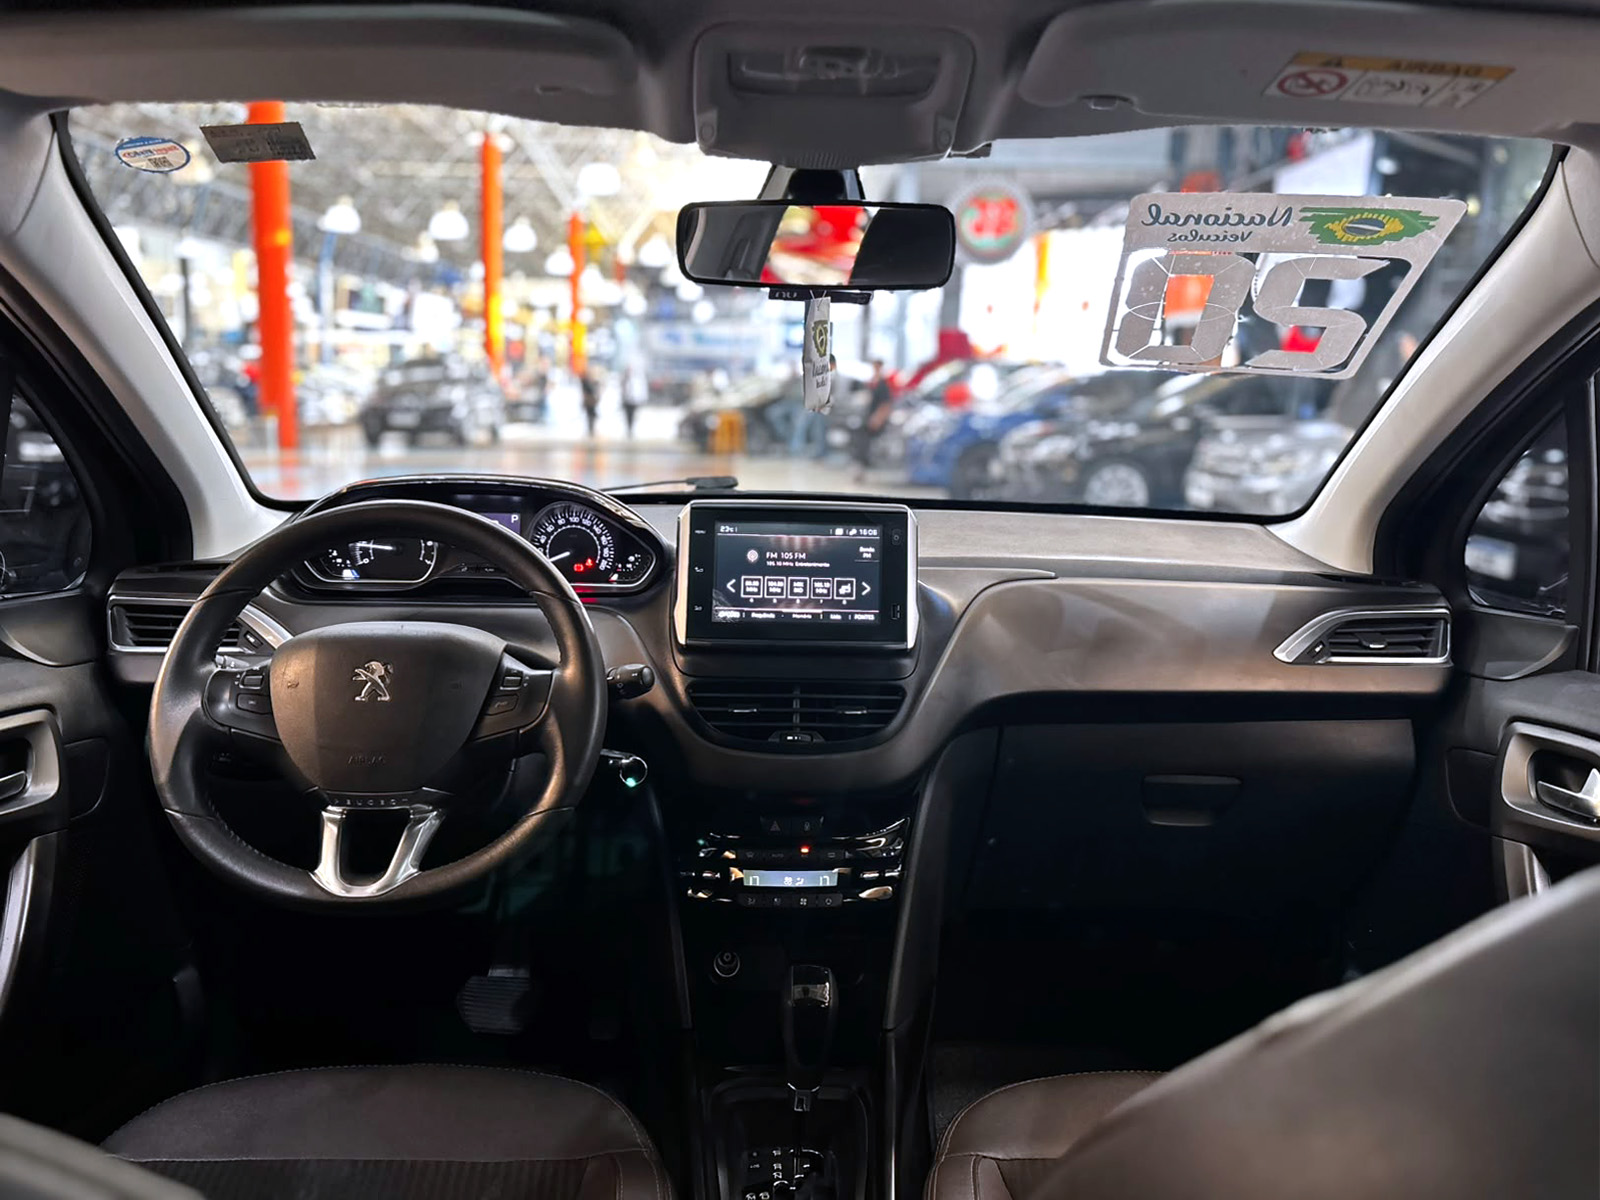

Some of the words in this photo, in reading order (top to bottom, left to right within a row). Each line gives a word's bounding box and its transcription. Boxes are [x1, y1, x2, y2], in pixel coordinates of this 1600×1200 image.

[511, 514, 519, 523] P
[582, 518, 592, 526] 120
[593, 525, 603, 535] 140
[766, 551, 778, 559] FM
[781, 551, 793, 560] 105
[794, 552, 806, 560] FM
